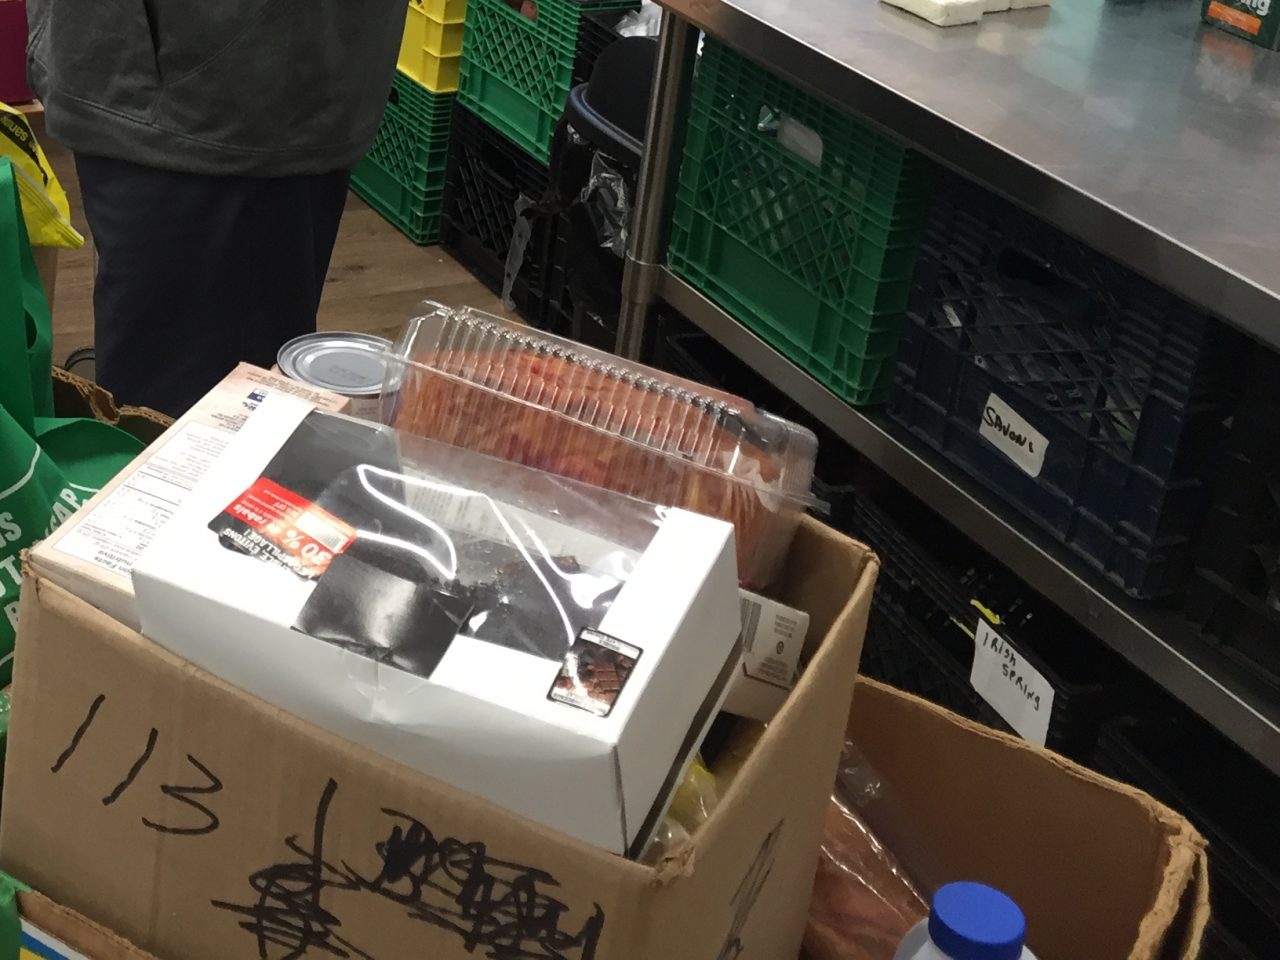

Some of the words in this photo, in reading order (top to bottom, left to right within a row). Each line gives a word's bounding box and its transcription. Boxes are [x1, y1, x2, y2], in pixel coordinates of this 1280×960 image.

[232, 502, 268, 525] rabais
[222, 527, 262, 553] ÉVITONS
[93, 555, 117, 569] Facts
[97, 550, 133, 567] nutritive
[50, 693, 224, 837] 113
